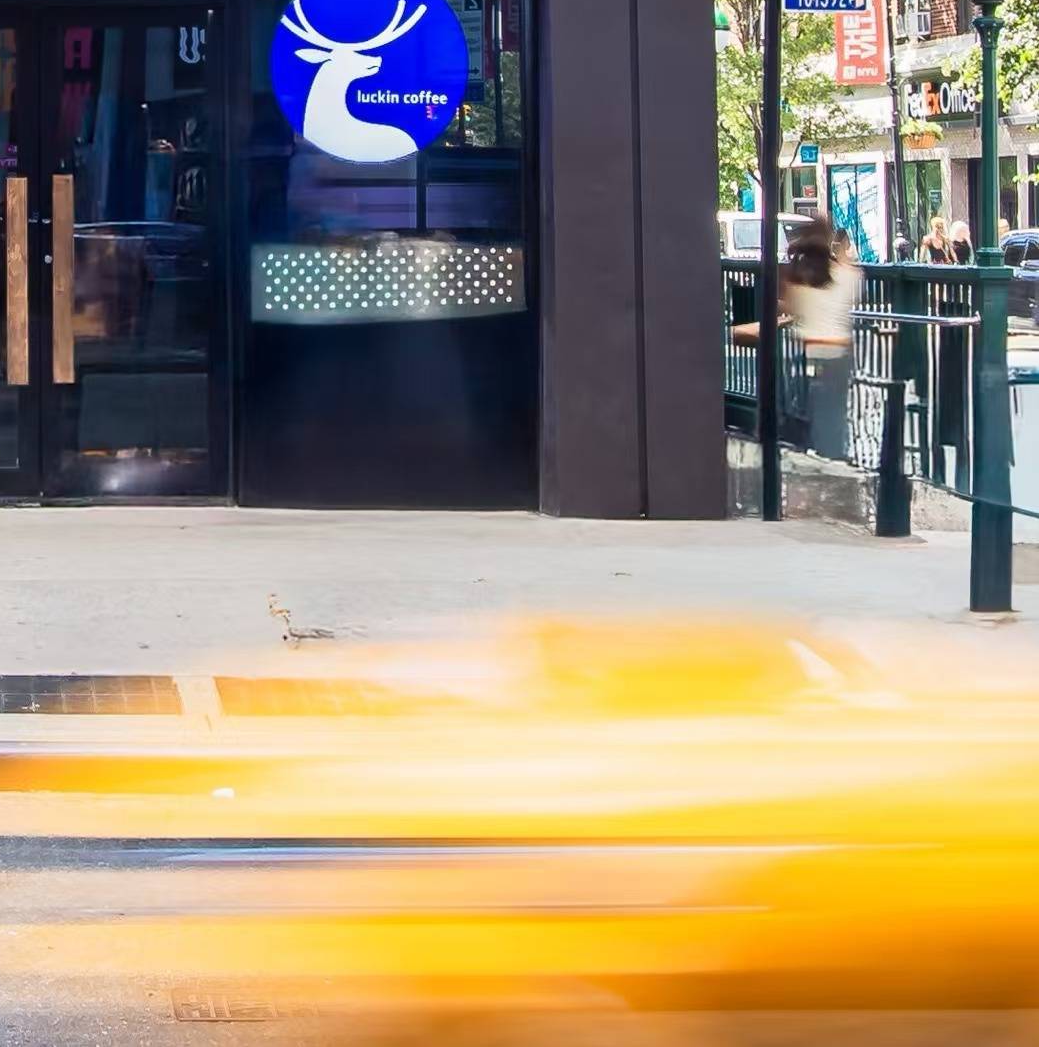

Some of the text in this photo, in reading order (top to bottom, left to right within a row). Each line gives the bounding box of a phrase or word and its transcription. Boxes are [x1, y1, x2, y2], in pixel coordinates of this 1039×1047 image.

[843, 15, 861, 60] THE
[857, 67, 879, 77] NYU
[357, 89, 448, 105] luckin coffee
